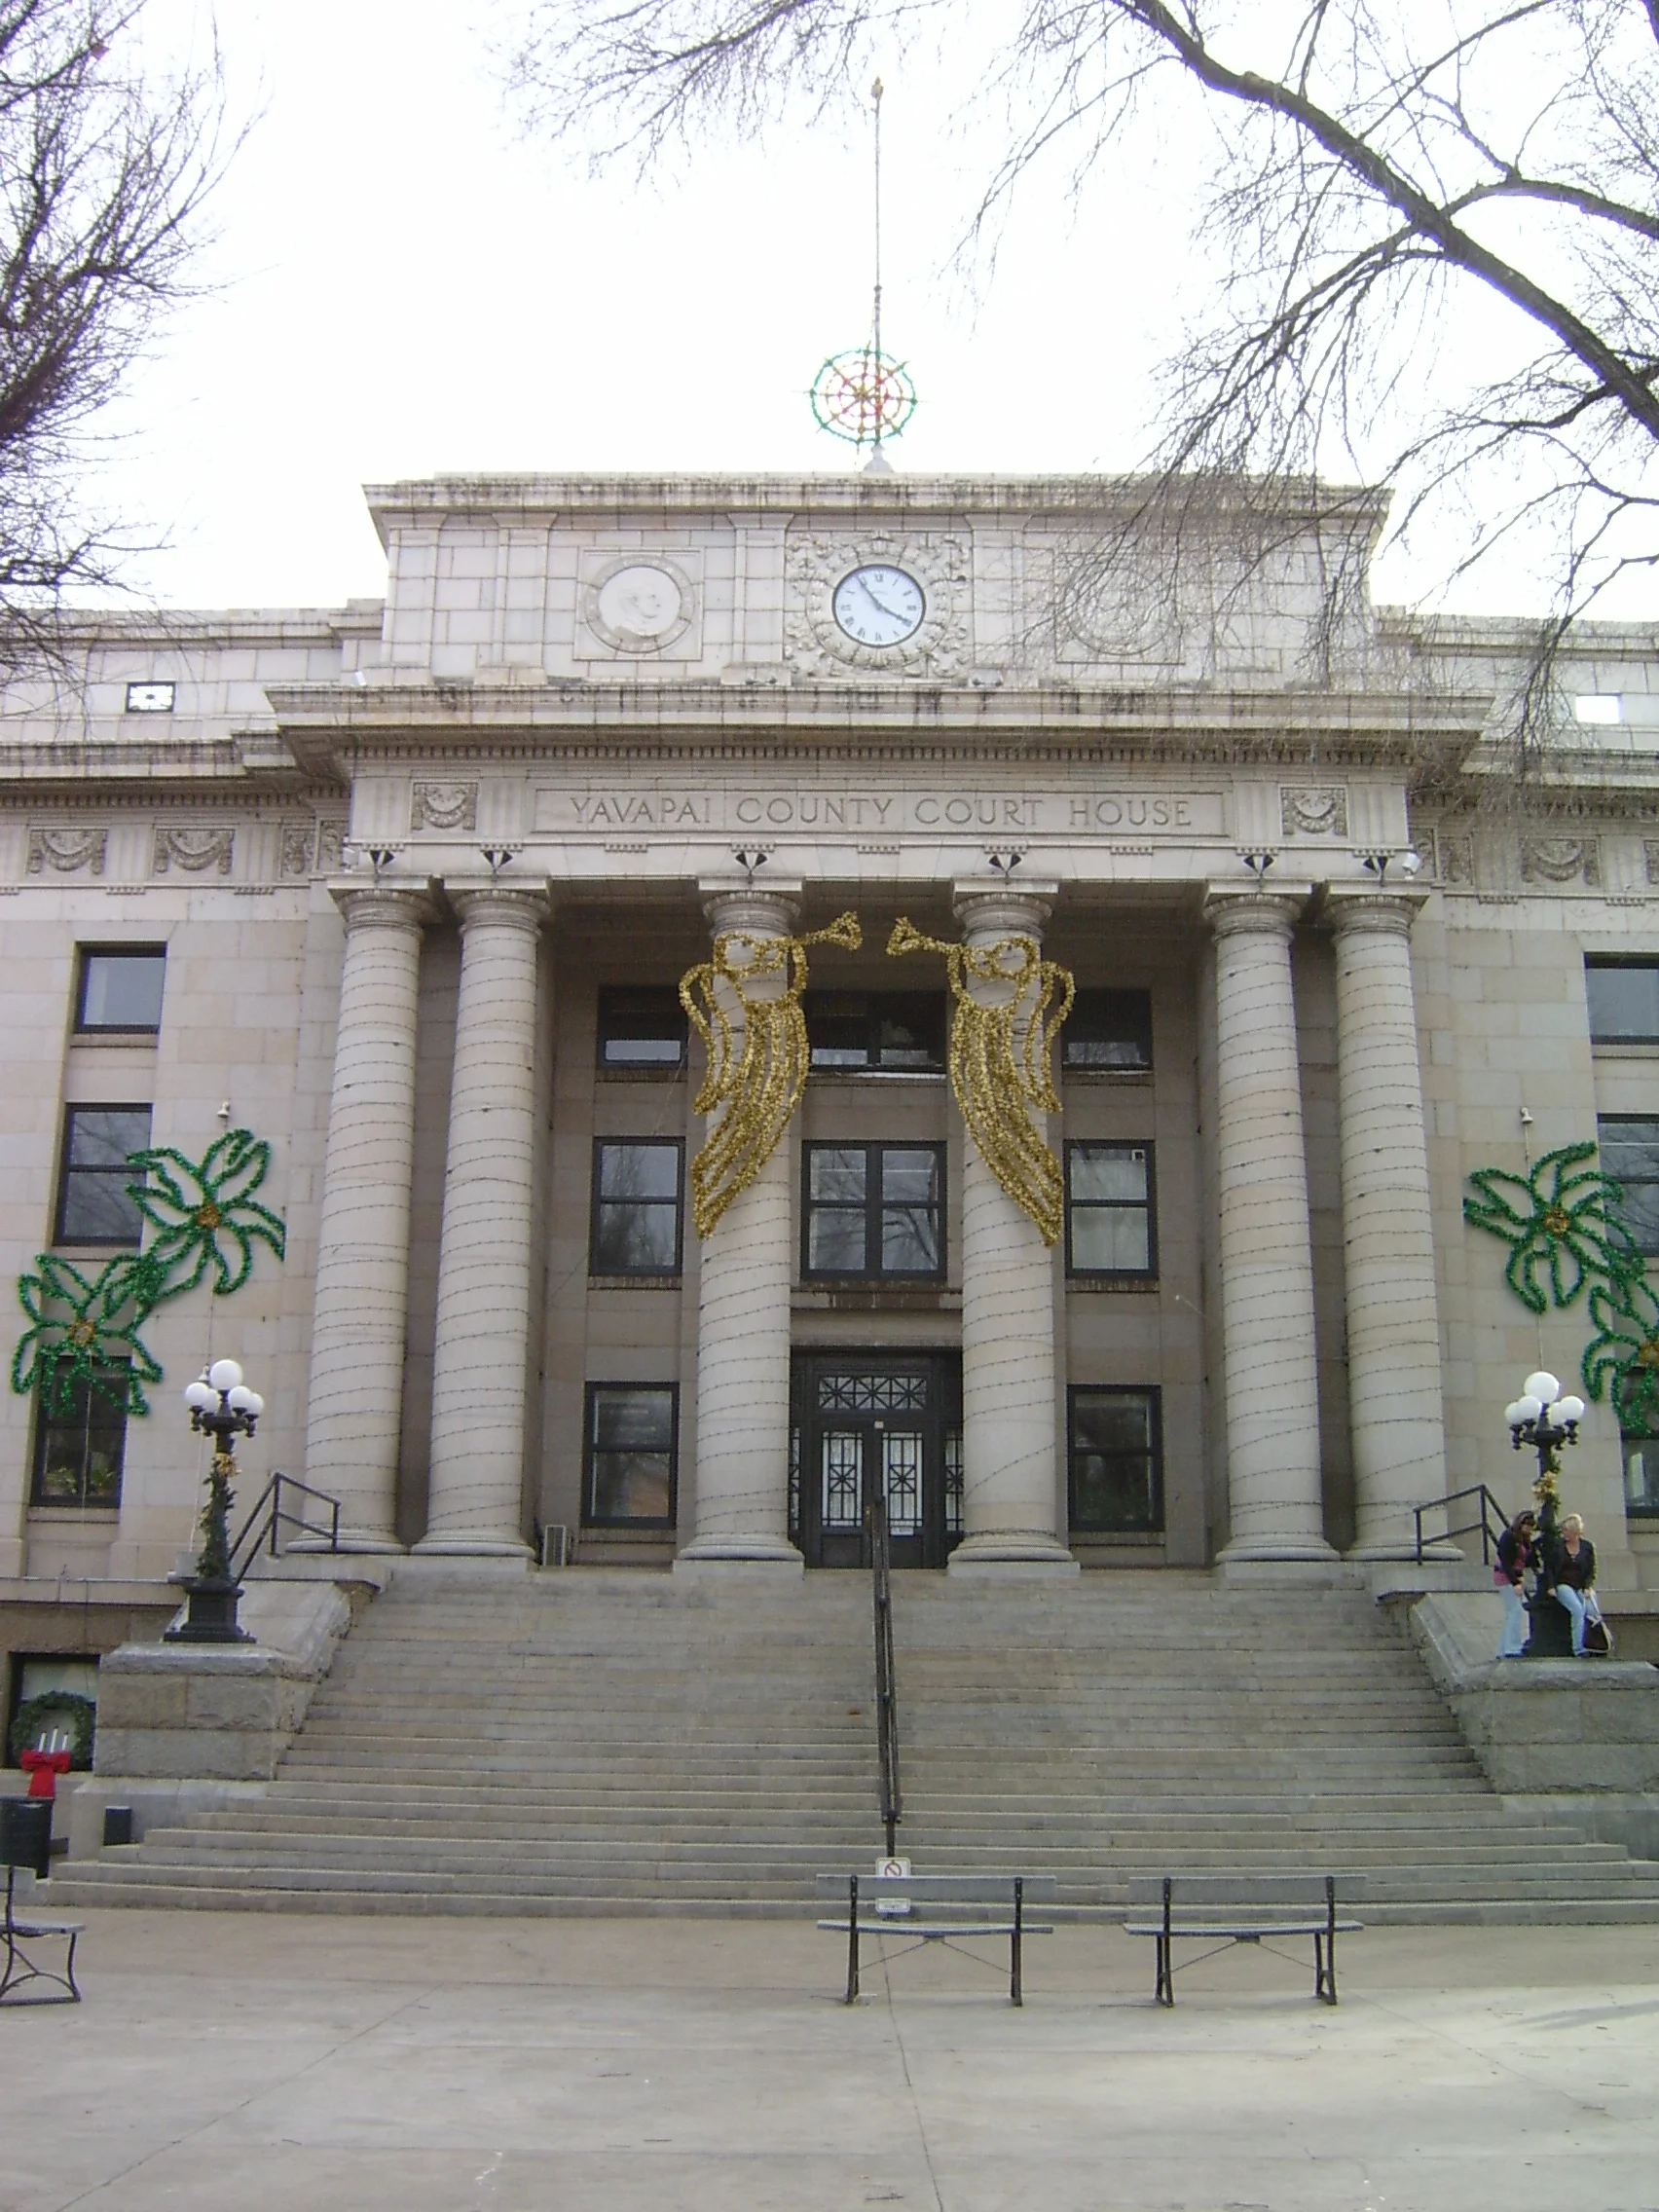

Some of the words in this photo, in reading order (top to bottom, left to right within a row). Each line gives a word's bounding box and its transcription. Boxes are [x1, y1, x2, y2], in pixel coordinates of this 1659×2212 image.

[571, 797, 711, 824] YAVAPAI
[735, 797, 894, 825] COUNTY
[915, 798, 1043, 826] COURT
[1069, 799, 1193, 827] HOUSE
